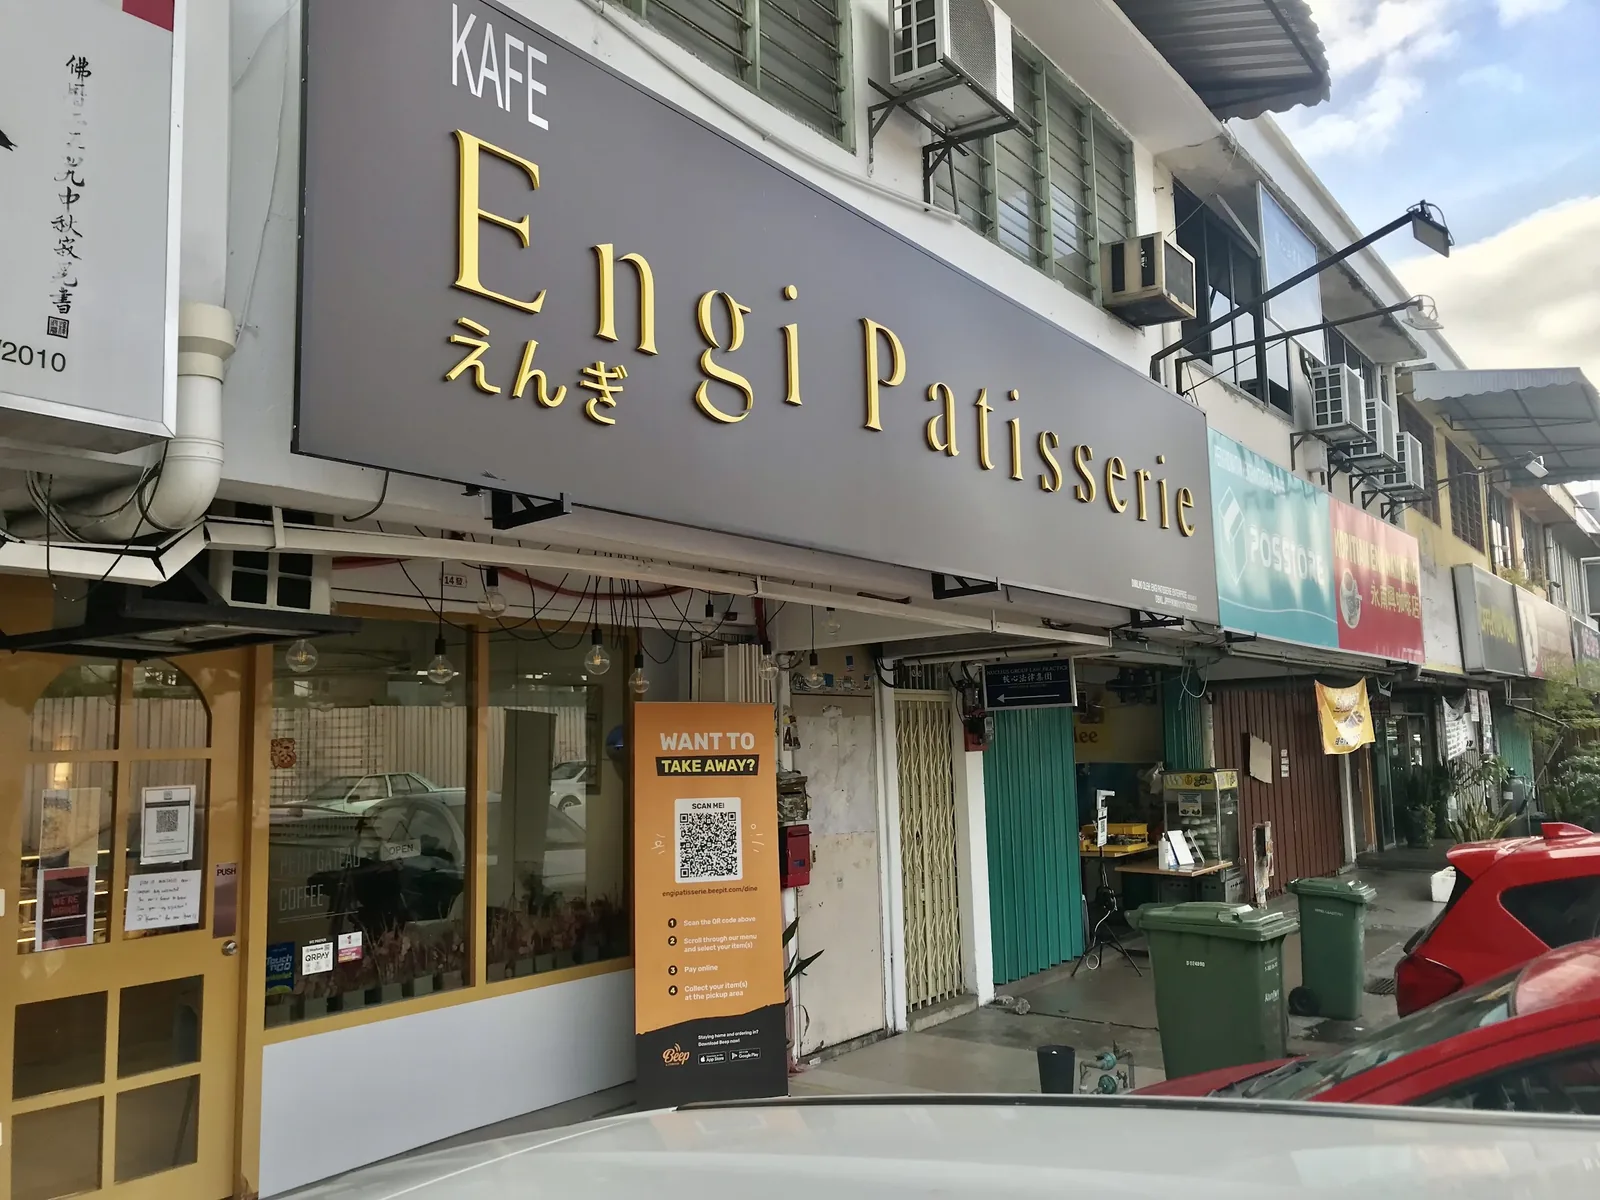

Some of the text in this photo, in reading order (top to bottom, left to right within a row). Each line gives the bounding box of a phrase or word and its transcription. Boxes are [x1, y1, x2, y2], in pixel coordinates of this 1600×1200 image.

[451, 3, 549, 131] KAFE
[451, 128, 803, 424] Engi
[445, 316, 629, 425] えんぎ
[859, 316, 1196, 538] Patisserie
[1074, 726, 1098, 744] ee
[660, 732, 755, 751] WANT TO
[661, 758, 756, 773] TAKE AWAY?
[389, 844, 414, 855] OPEN
[216, 868, 237, 877] PUSH
[662, 885, 758, 897] engipatisserie.beepit.com/dine
[279, 884, 324, 911] COFFEE
[683, 919, 700, 927] Scan
[700, 918, 711, 926] the
[737, 915, 756, 923] above
[683, 937, 702, 945] Scroll
[702, 935, 728, 945] through
[683, 941, 753, 953] and select your item(s)
[305, 951, 330, 962] QRPAY
[684, 966, 697, 975] Pay
[697, 964, 719, 972] online
[684, 983, 708, 993] Collect
[709, 983, 724, 992] your
[724, 980, 748, 990] item(s)
[684, 993, 693, 1001] at
[693, 992, 705, 1000] the
[705, 991, 728, 1001] pickup
[698, 1033, 715, 1041] Staying
[735, 1030, 752, 1038] ordering
[662, 1046, 691, 1066] Beep
